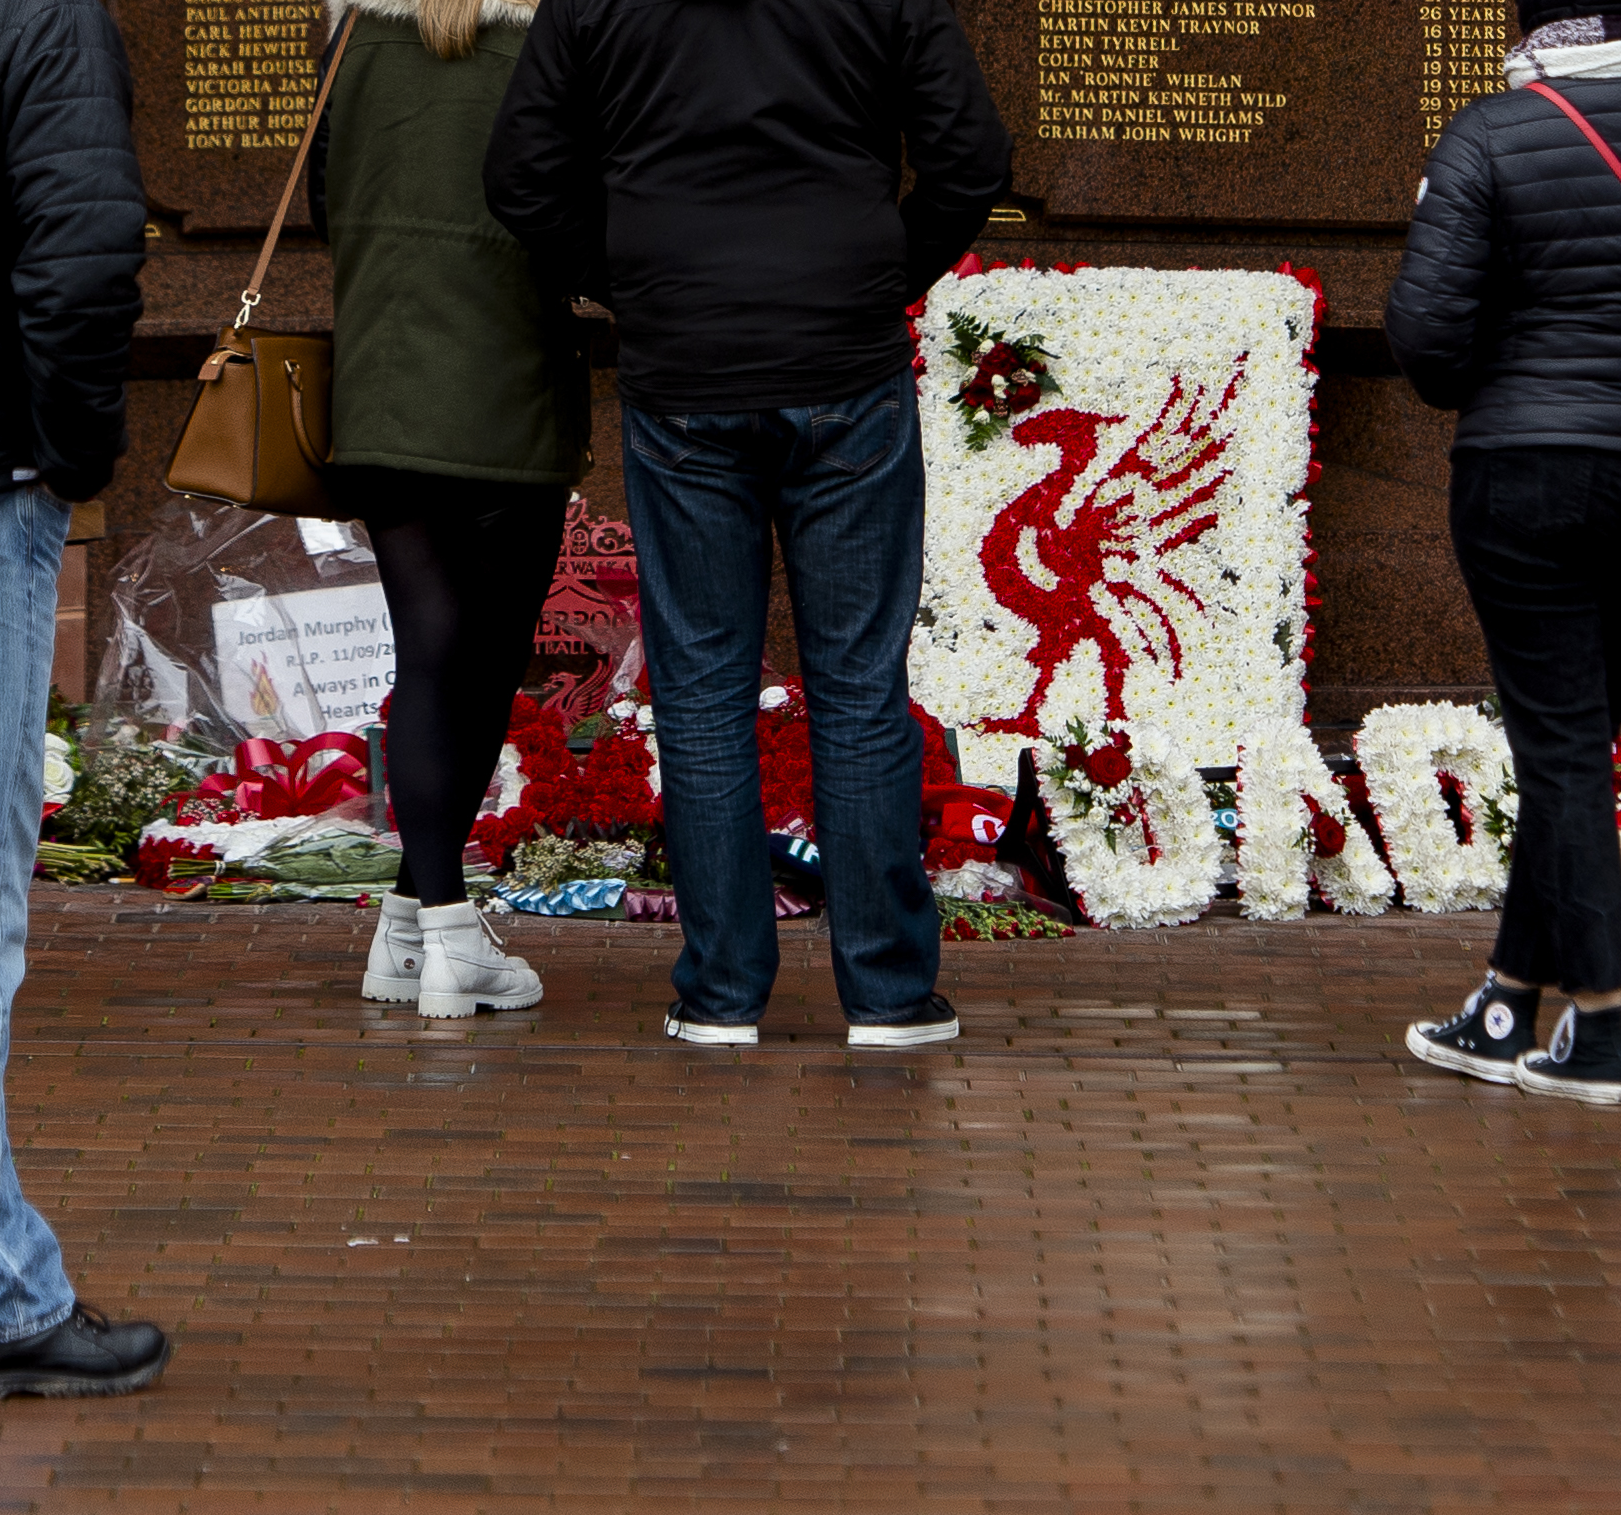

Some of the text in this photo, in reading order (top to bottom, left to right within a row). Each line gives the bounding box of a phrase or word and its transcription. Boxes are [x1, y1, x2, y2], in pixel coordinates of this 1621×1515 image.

[1036, 0, 1317, 14] CHRISTOPHER JAMES TRAYNOR
[1038, 106, 1265, 123] KEVIN DANIEL WILLIAMS
[186, 132, 300, 148] TONY BLAND
[1036, 124, 1253, 143] GRAHAM JOHN WRIGHT
[237, 626, 300, 647] Jordan
[303, 616, 378, 639] Murphy
[362, 672, 380, 689] in
[320, 700, 379, 720] Hearts
